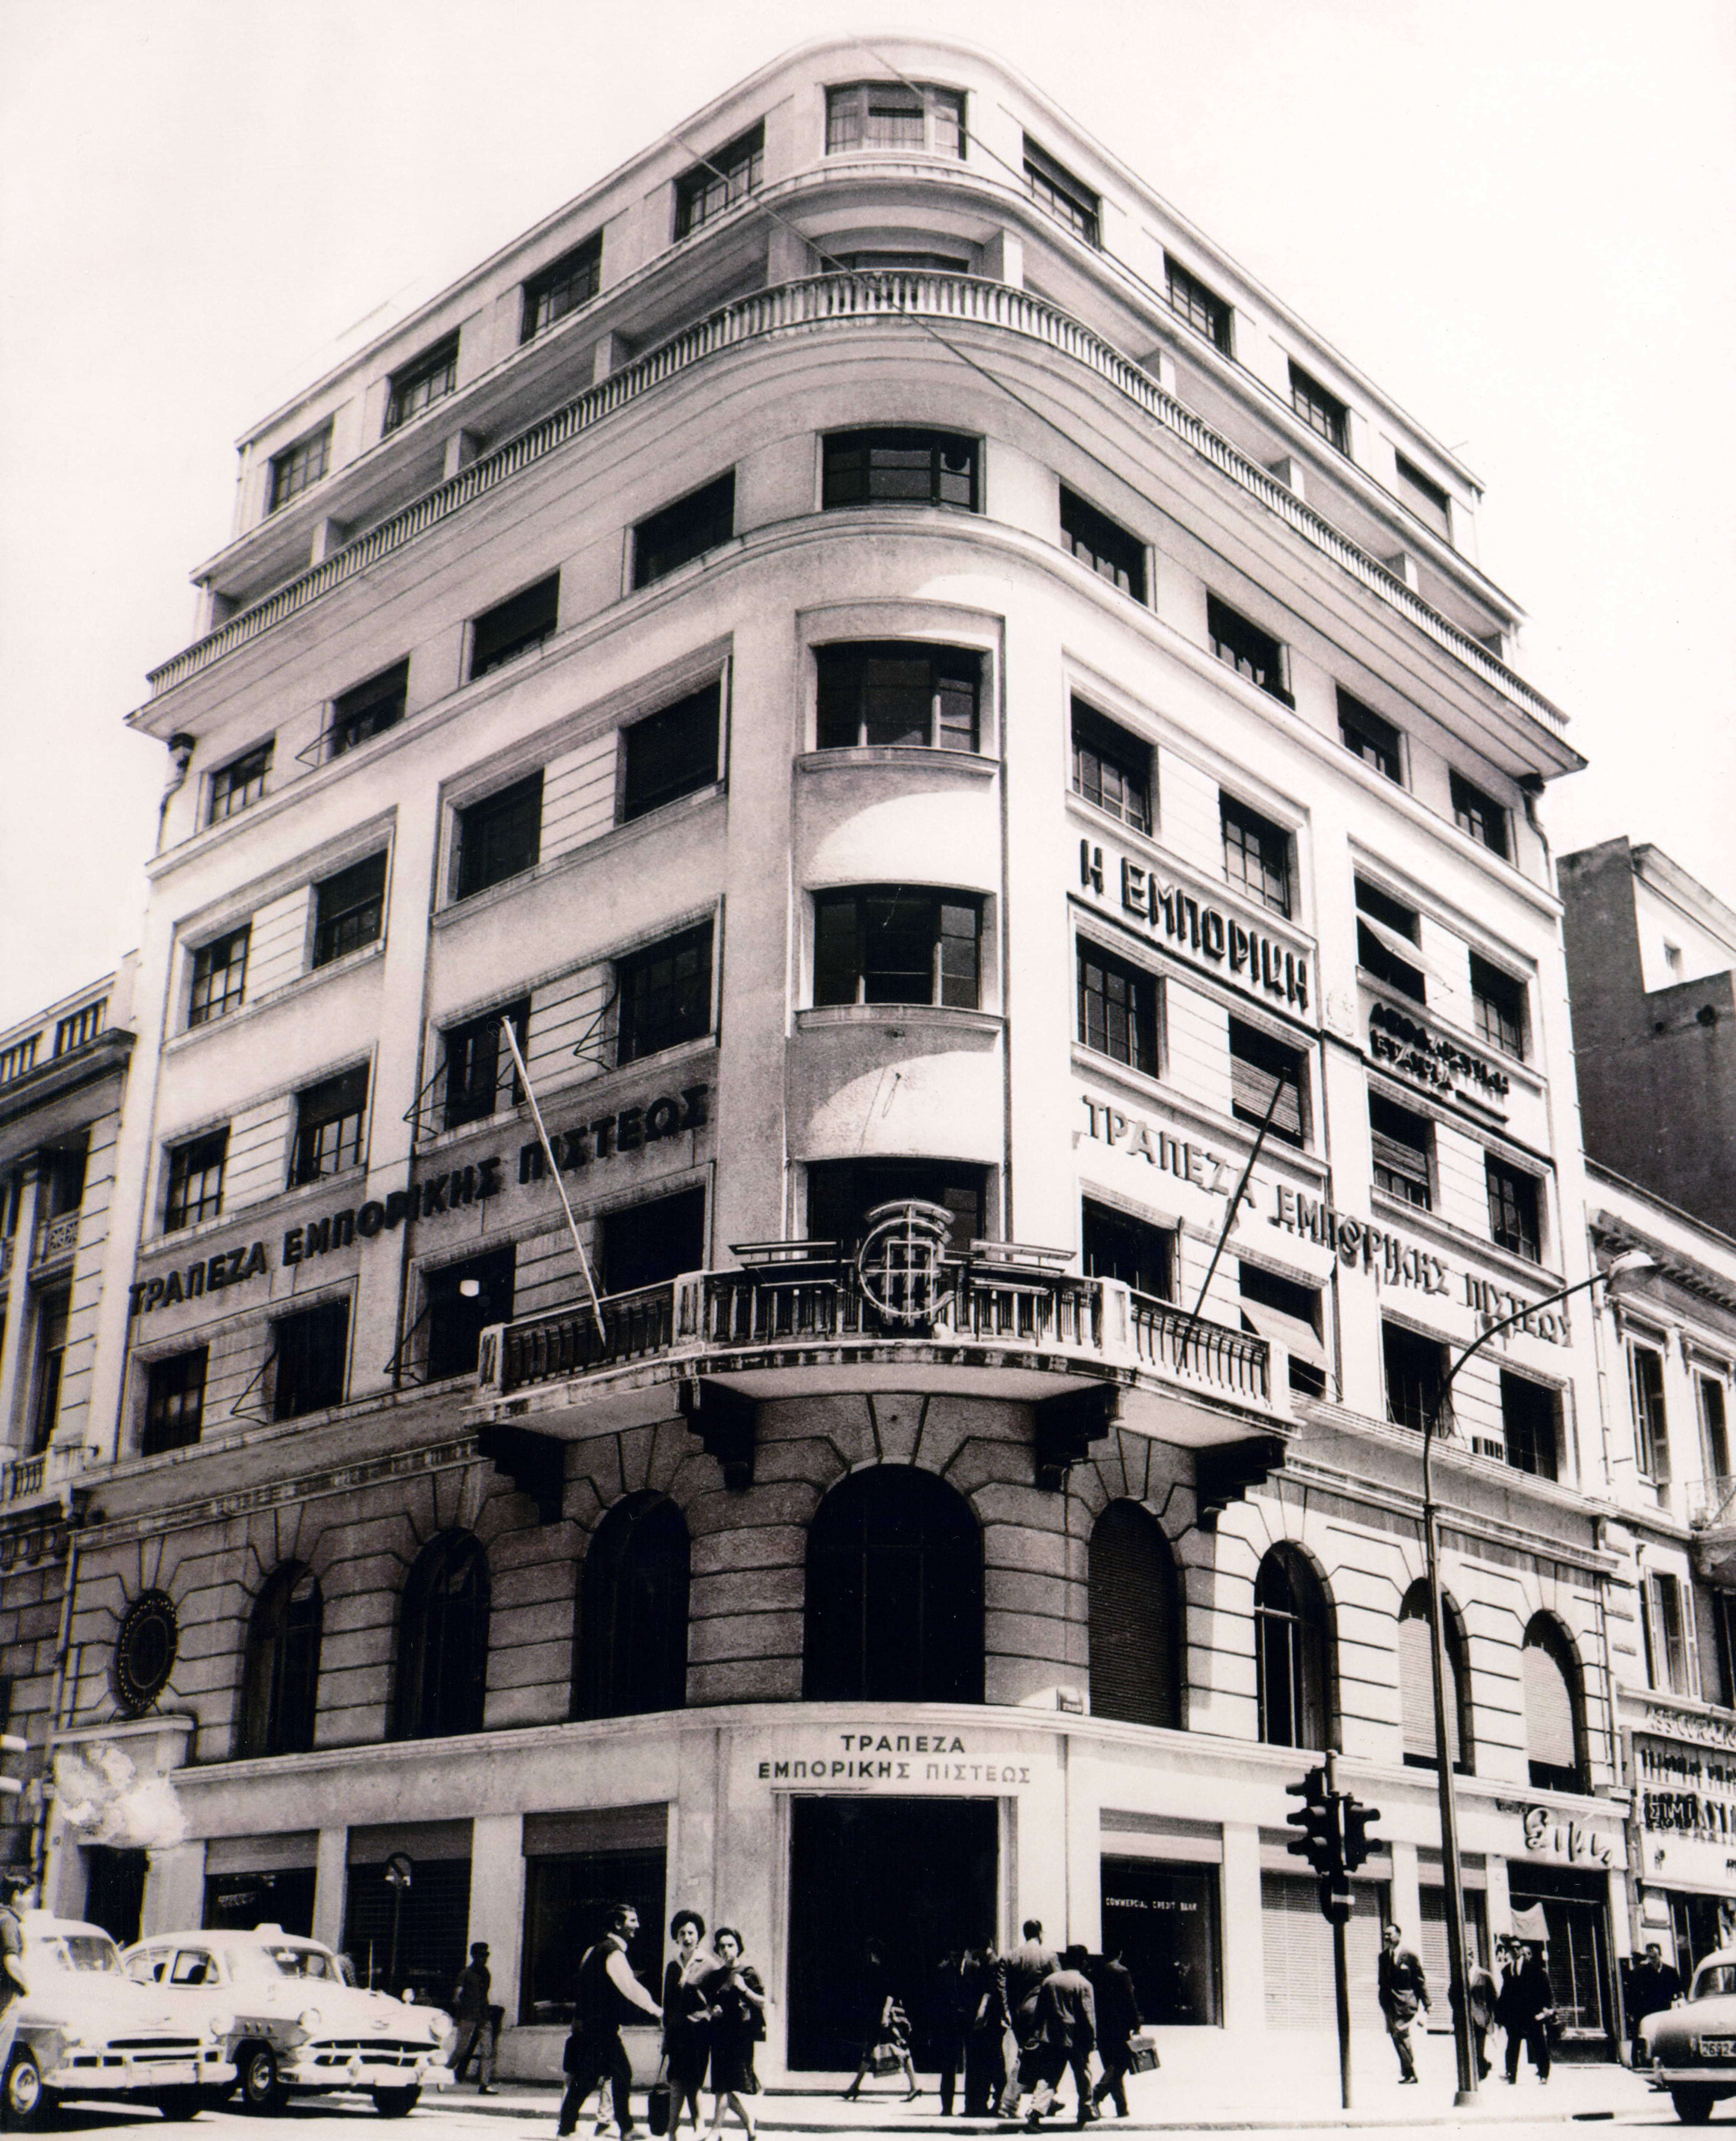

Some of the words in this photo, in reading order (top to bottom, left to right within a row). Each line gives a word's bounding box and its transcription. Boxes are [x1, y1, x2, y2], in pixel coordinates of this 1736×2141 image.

[1080, 838, 1103, 894] Η
[1121, 856, 1309, 1010] ΕΜΠΟΡΙΚΗ
[129, 1241, 267, 1316] ΤΡΑΠΕΖΑ
[282, 1156, 501, 1266] ΕΜΠΟΡΙΚΗΣ
[519, 1083, 708, 1184] ΠΙΣΤΕΩΣ
[1082, 1095, 1257, 1209] ΤΡΑΠΕΖΑ
[1277, 1185, 1450, 1297] ΕΜΠΟΡΙΚΗΣ
[758, 1761, 910, 1779] ΕΜΠΟΡΙΚΗΣ
[926, 1763, 1031, 1783] ΠΙΣΤΕΩΣ
[841, 1735, 966, 1754] ΤΡΑΠΕΖΑ
